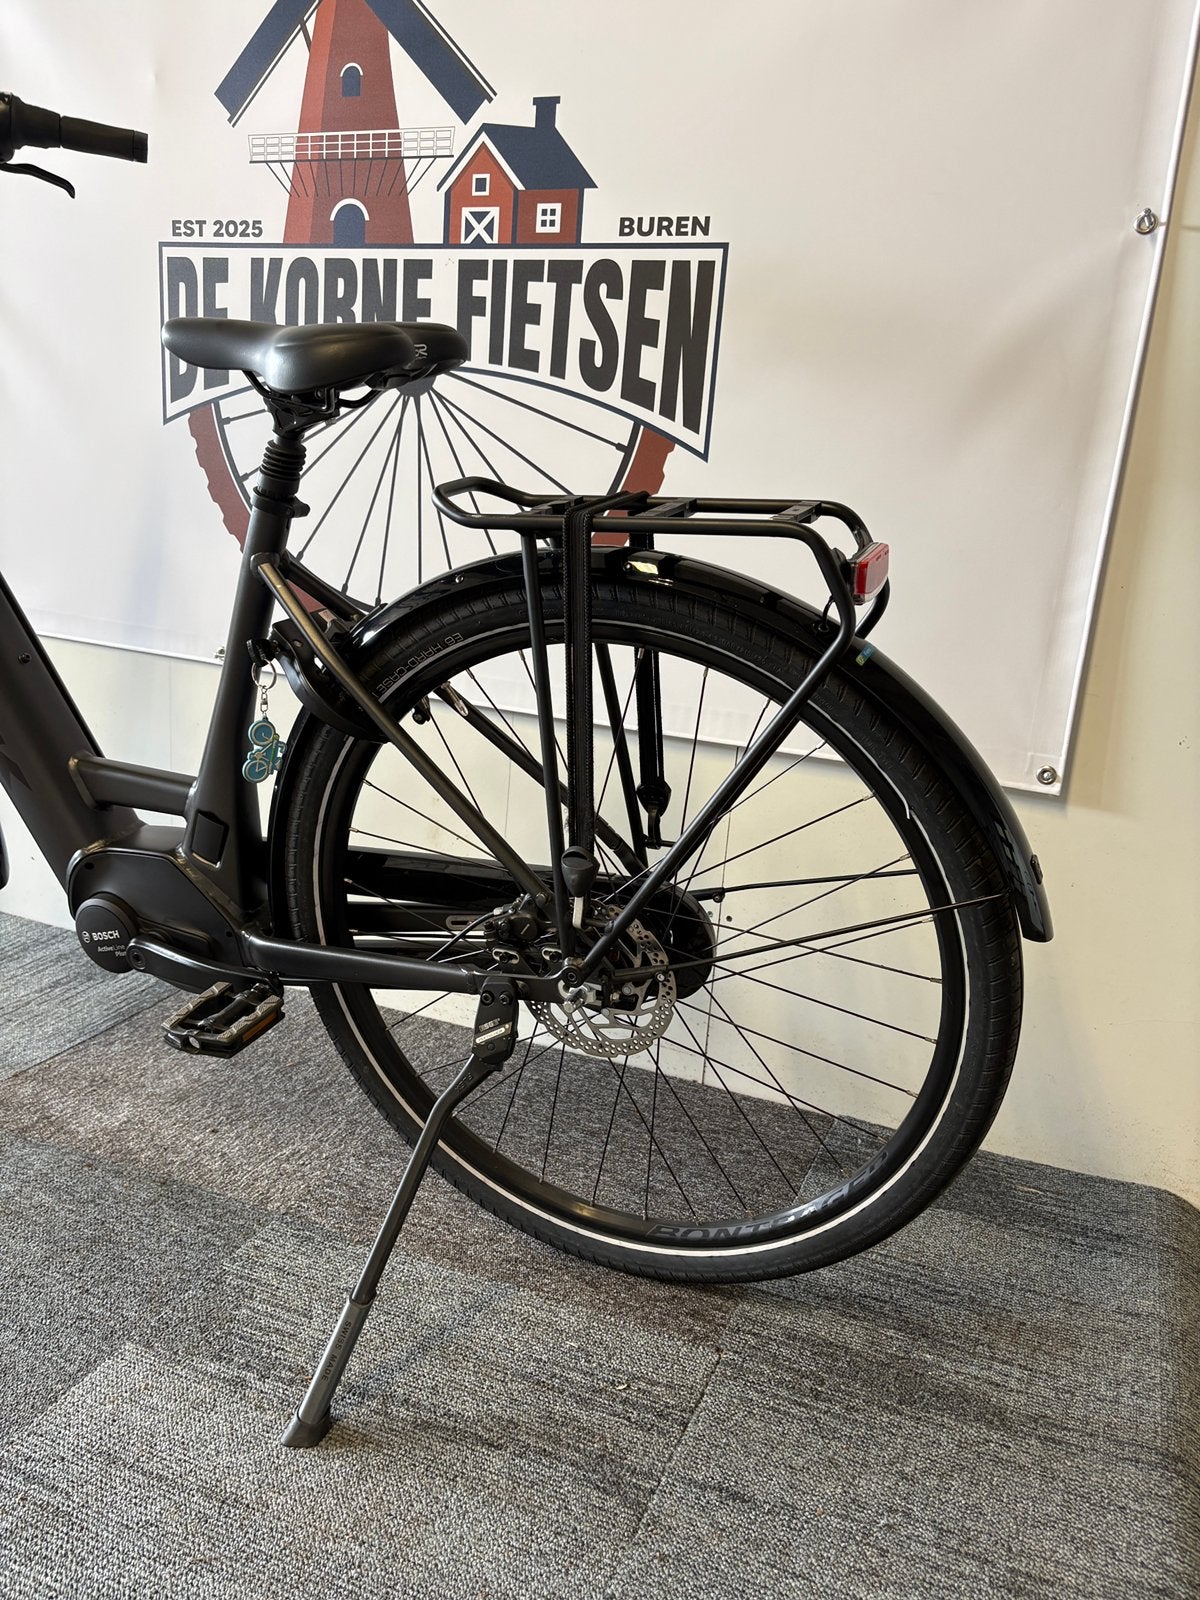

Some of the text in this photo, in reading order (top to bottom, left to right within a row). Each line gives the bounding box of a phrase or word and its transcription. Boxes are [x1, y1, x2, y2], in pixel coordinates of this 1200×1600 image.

[171, 219, 263, 237] EST 2025
[618, 215, 711, 237] BUREN
[166, 256, 229, 403] DE
[456, 258, 716, 435] FIETSEN
[444, 632, 464, 646] E6
[91, 930, 120, 941] BOSCH
